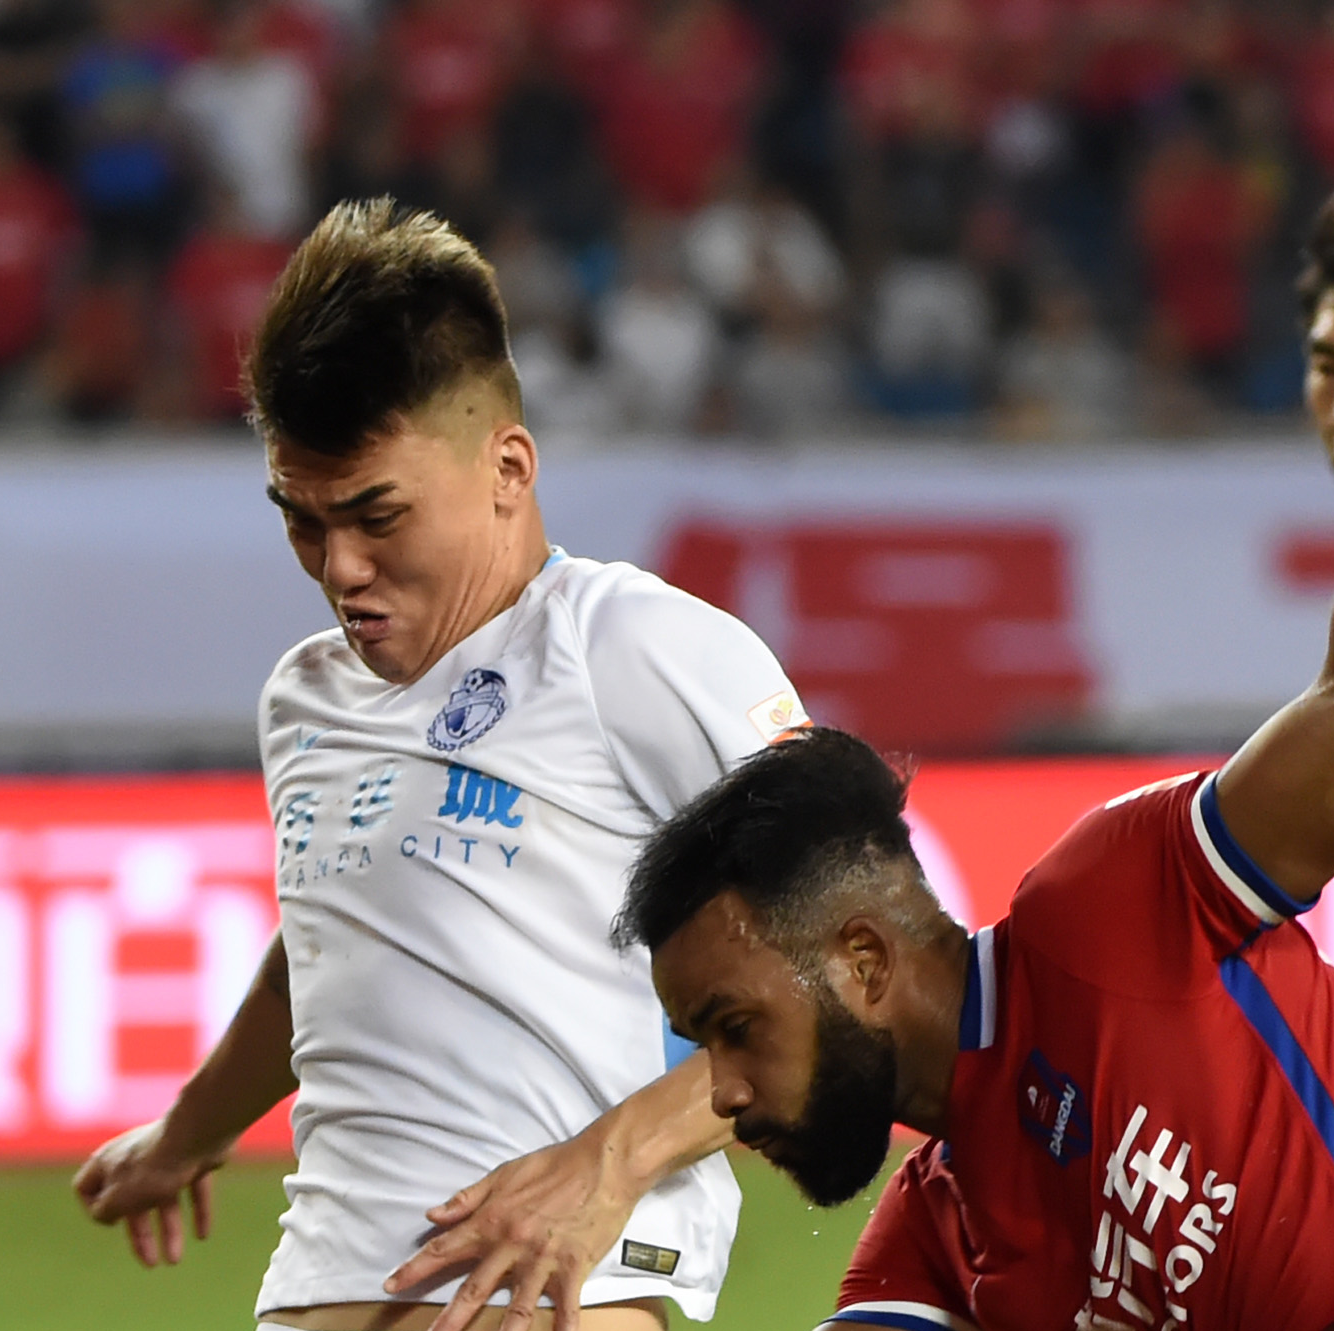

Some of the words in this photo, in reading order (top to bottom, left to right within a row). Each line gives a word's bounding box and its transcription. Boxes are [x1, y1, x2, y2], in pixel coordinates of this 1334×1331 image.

[280, 844, 372, 892] ANDA
[400, 834, 521, 869] CITY
[1049, 1083, 1077, 1157] DANGDAI
